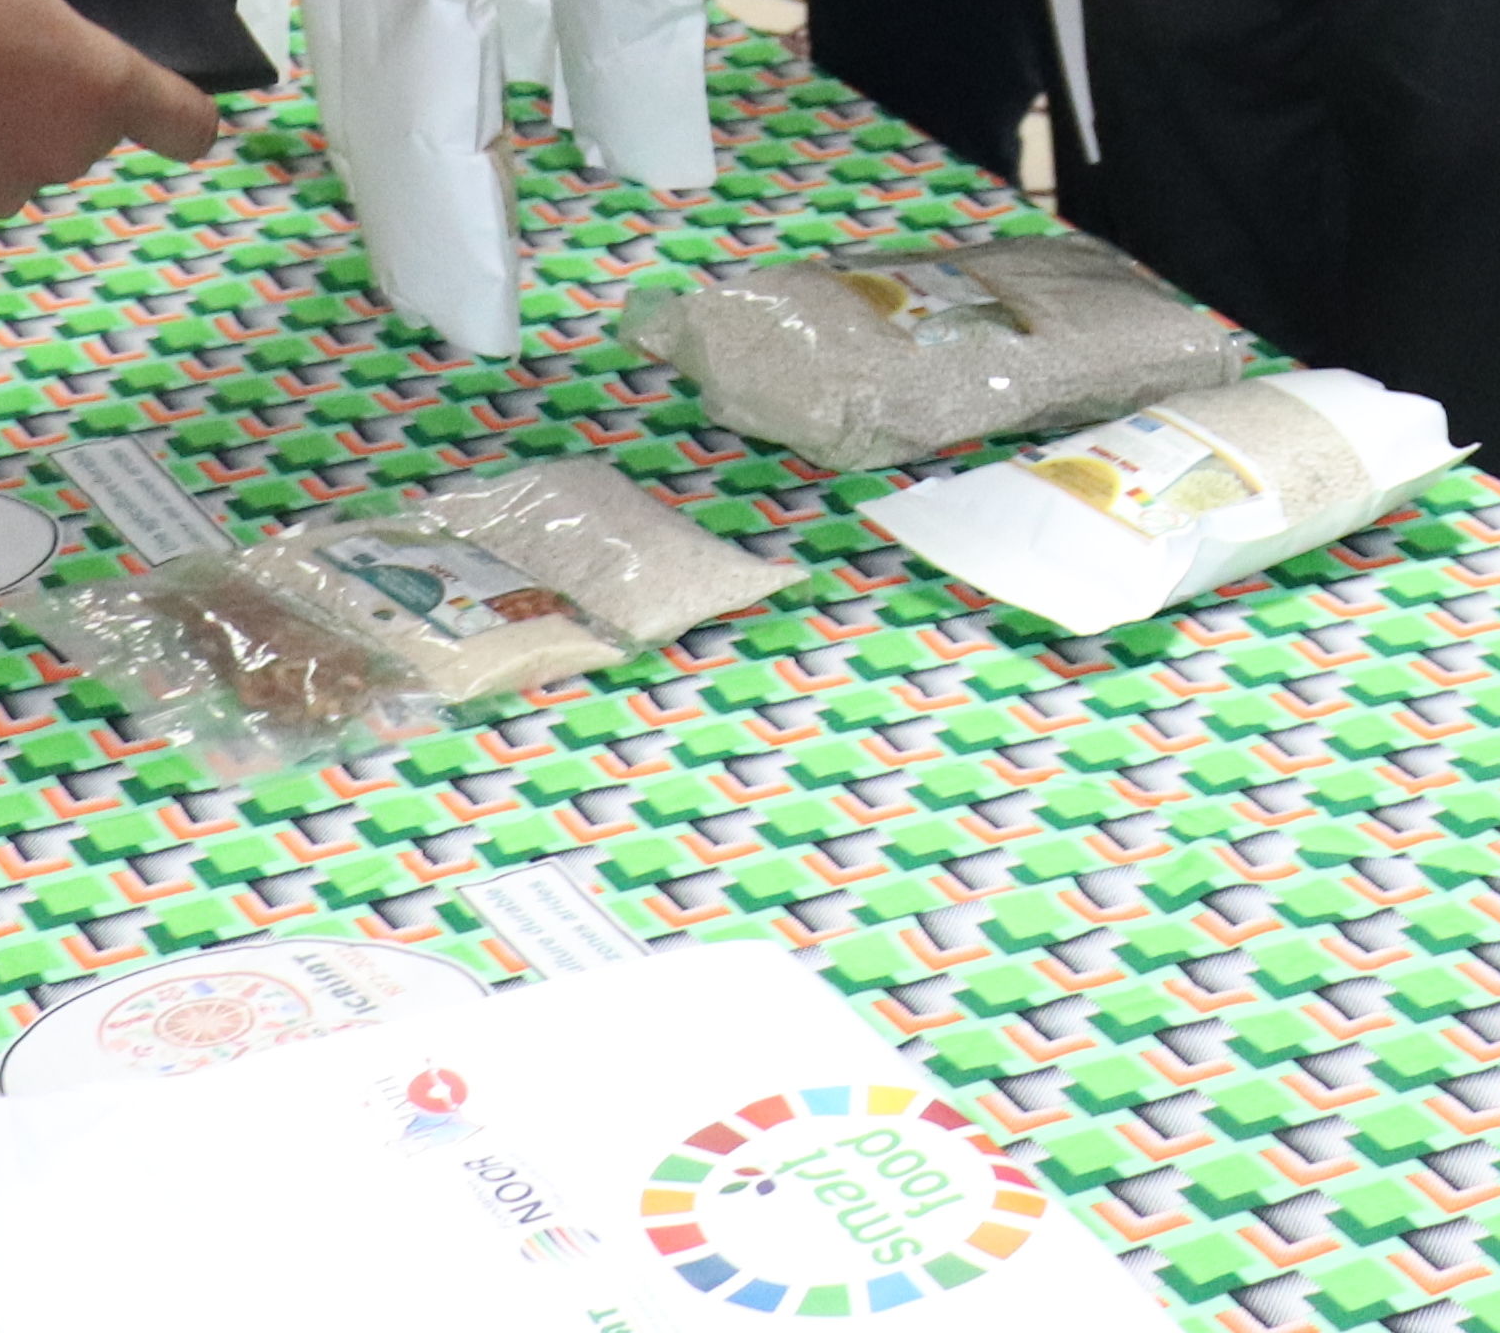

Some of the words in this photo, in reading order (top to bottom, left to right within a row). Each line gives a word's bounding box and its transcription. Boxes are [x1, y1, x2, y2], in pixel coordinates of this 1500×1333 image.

[292, 953, 379, 1016] ICRISAT
[463, 1155, 553, 1225] NOOR
[772, 1147, 923, 1265] smart
[835, 1128, 965, 1219] food
